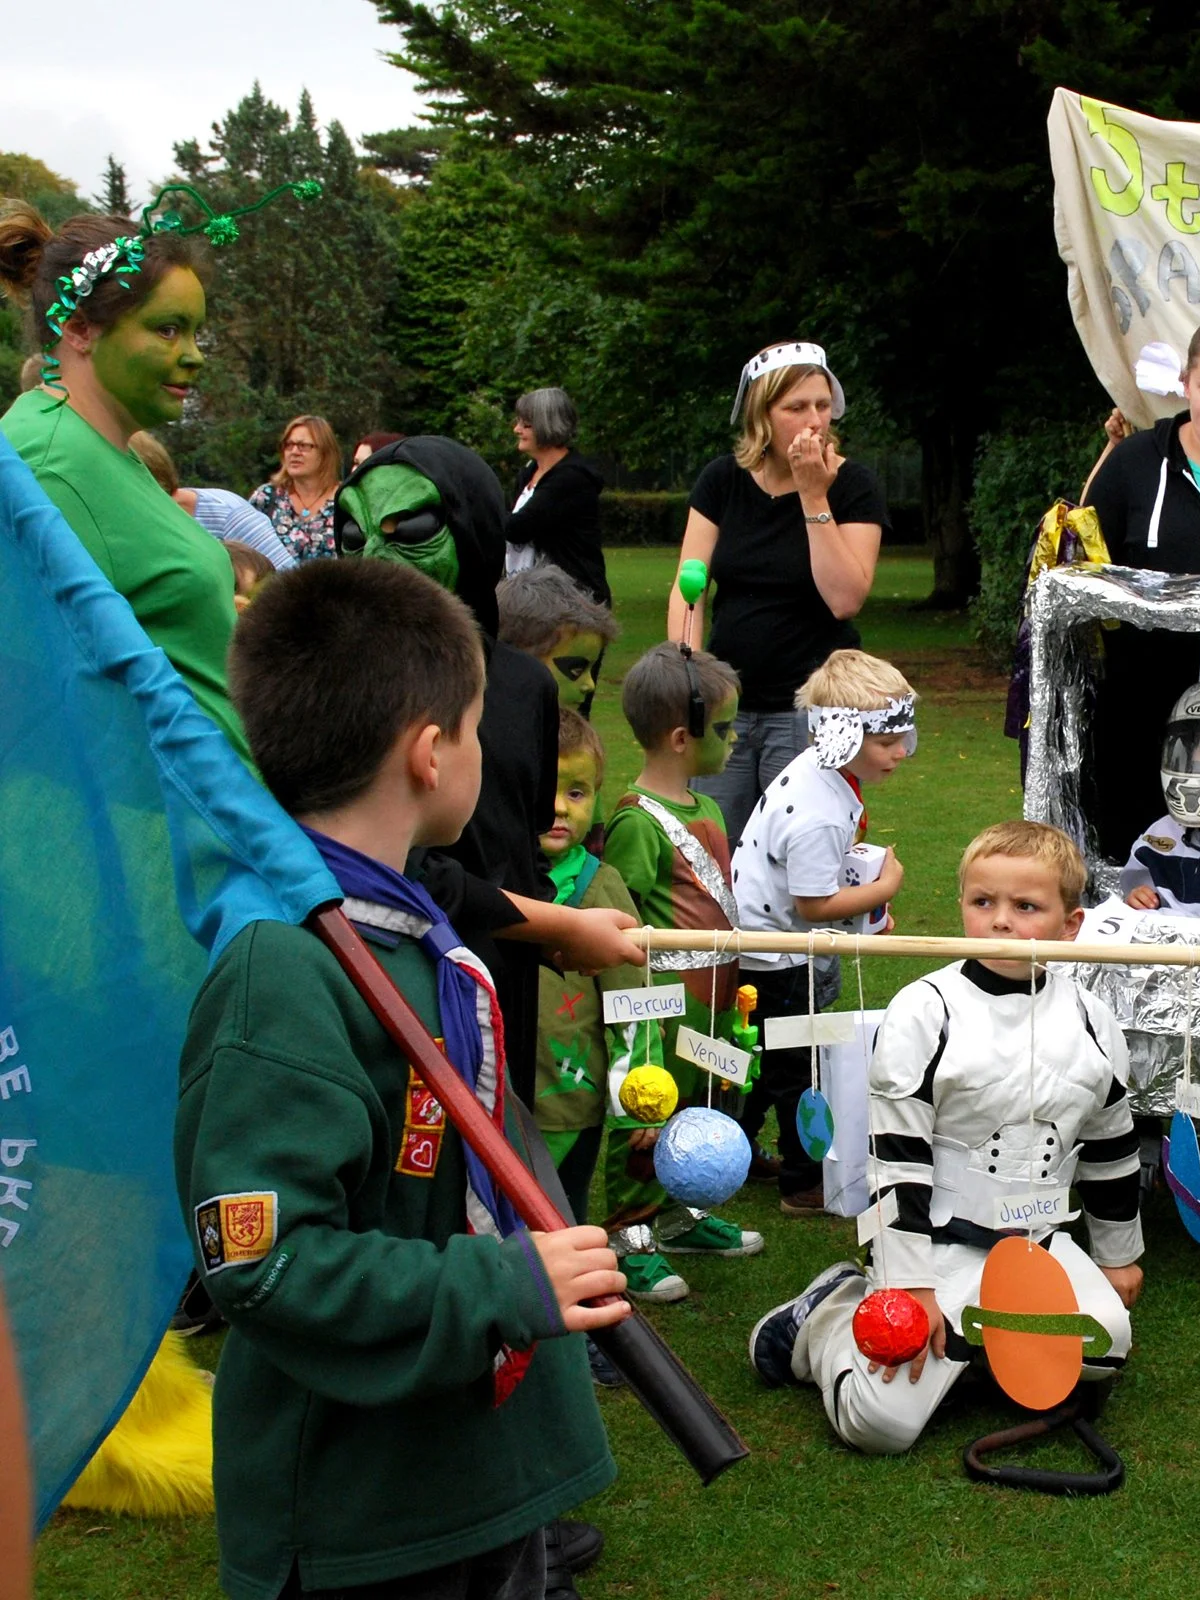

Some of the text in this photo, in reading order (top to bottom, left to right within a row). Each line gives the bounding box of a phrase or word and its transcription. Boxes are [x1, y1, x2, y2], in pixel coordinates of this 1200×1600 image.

[1097, 916, 1125, 935] 5
[612, 994, 683, 1019] Mercury
[688, 1037, 738, 1075] Venus
[1000, 1197, 1061, 1223] Jupiter
